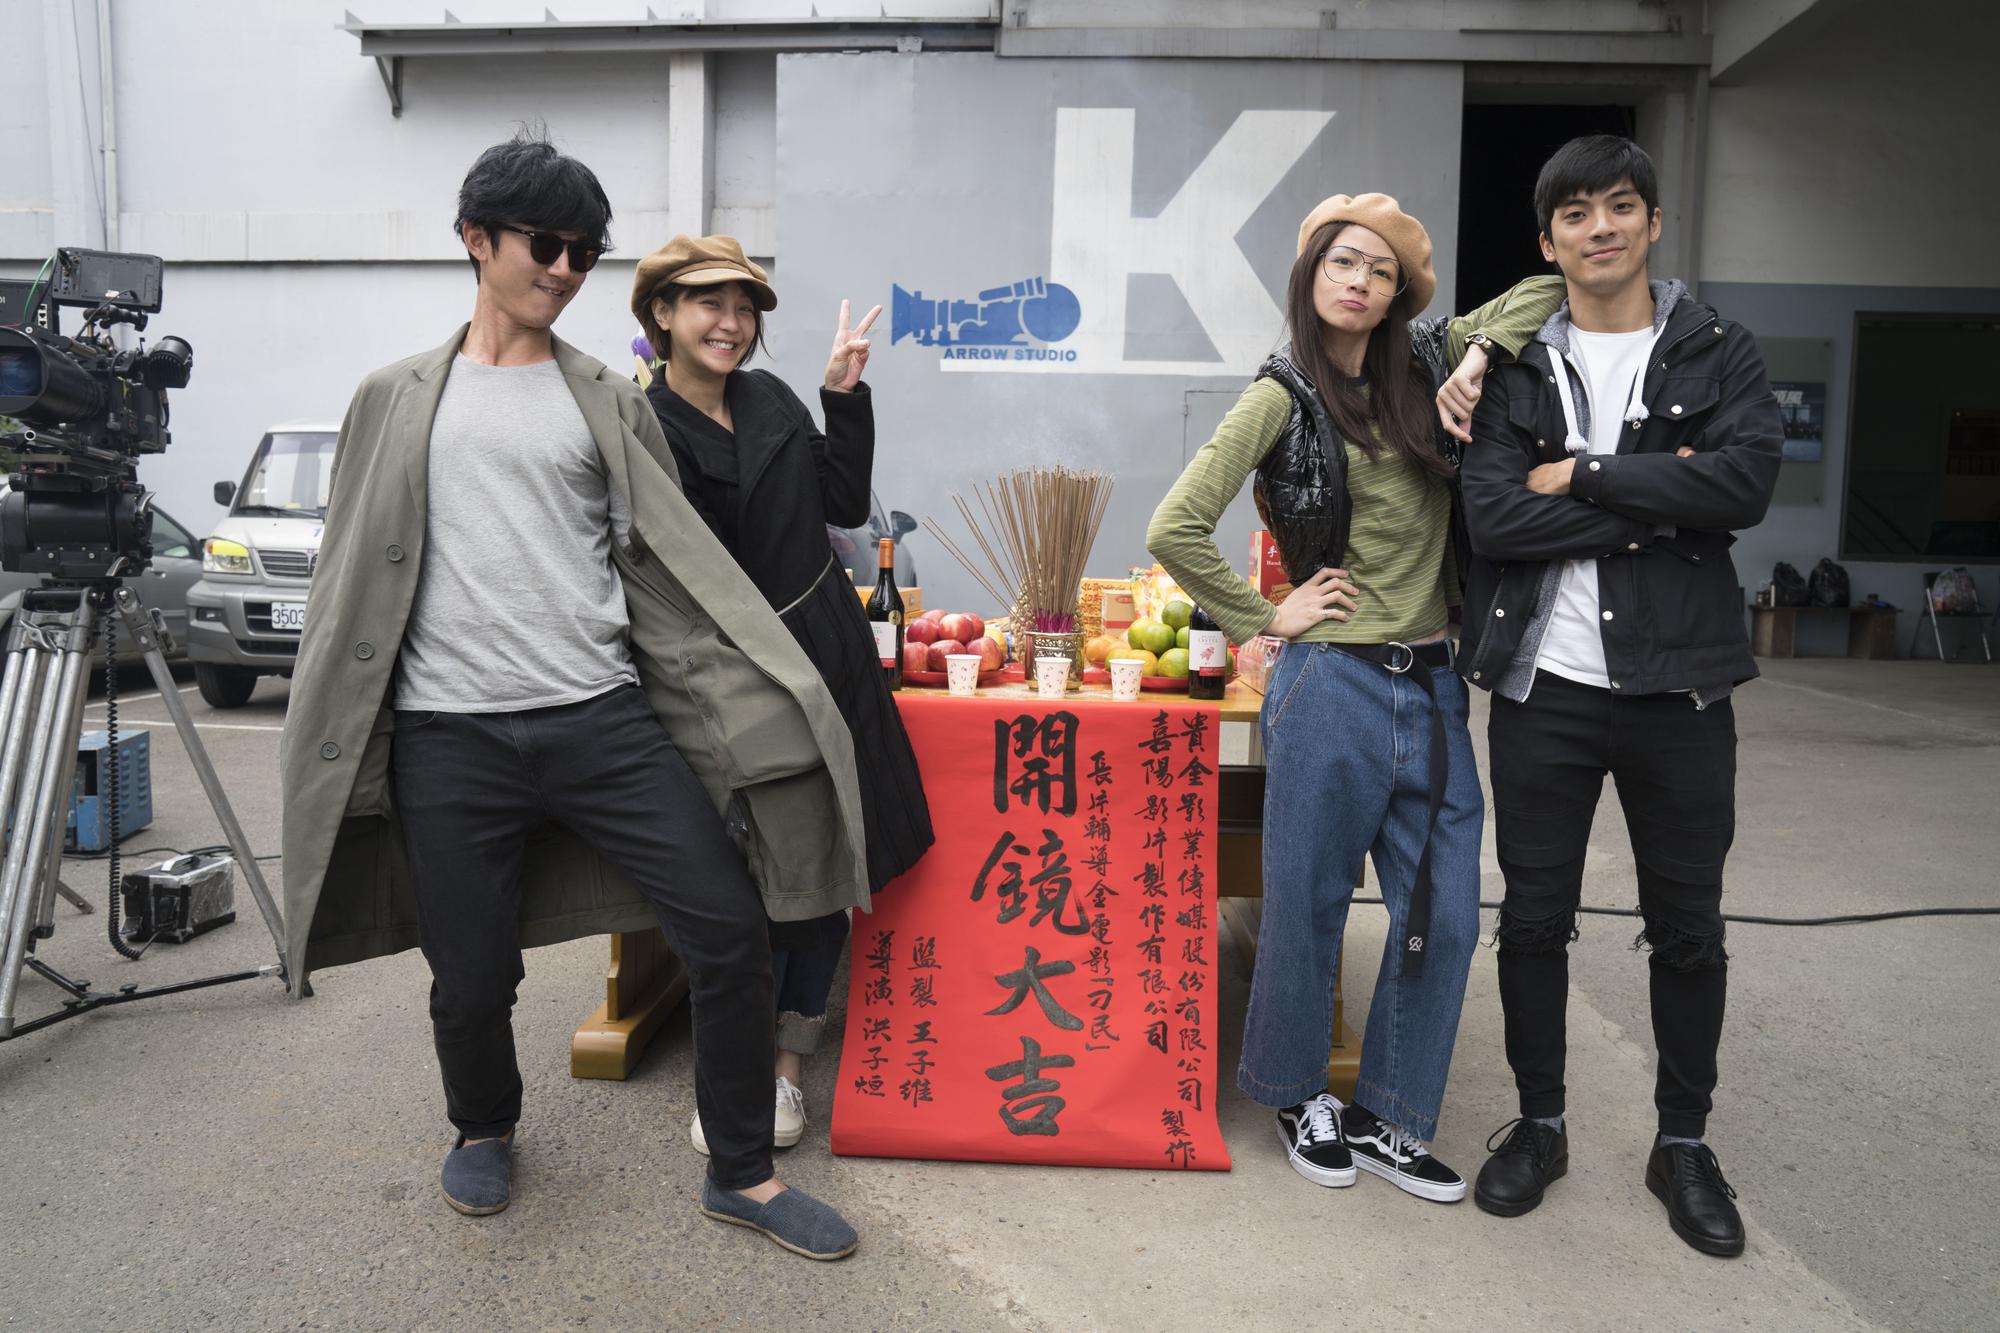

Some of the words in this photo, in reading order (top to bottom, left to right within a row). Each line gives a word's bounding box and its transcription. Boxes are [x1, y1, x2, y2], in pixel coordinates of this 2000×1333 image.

[943, 347, 1008, 360] ARROW
[1013, 348, 1078, 362] STUDIO
[1051, 107, 1337, 375] K
[971, 710, 1090, 1137] 開鏡大吉
[1134, 709, 1173, 1054] 喜陽影片製作有限公司
[1161, 1108, 1196, 1169] 製作
